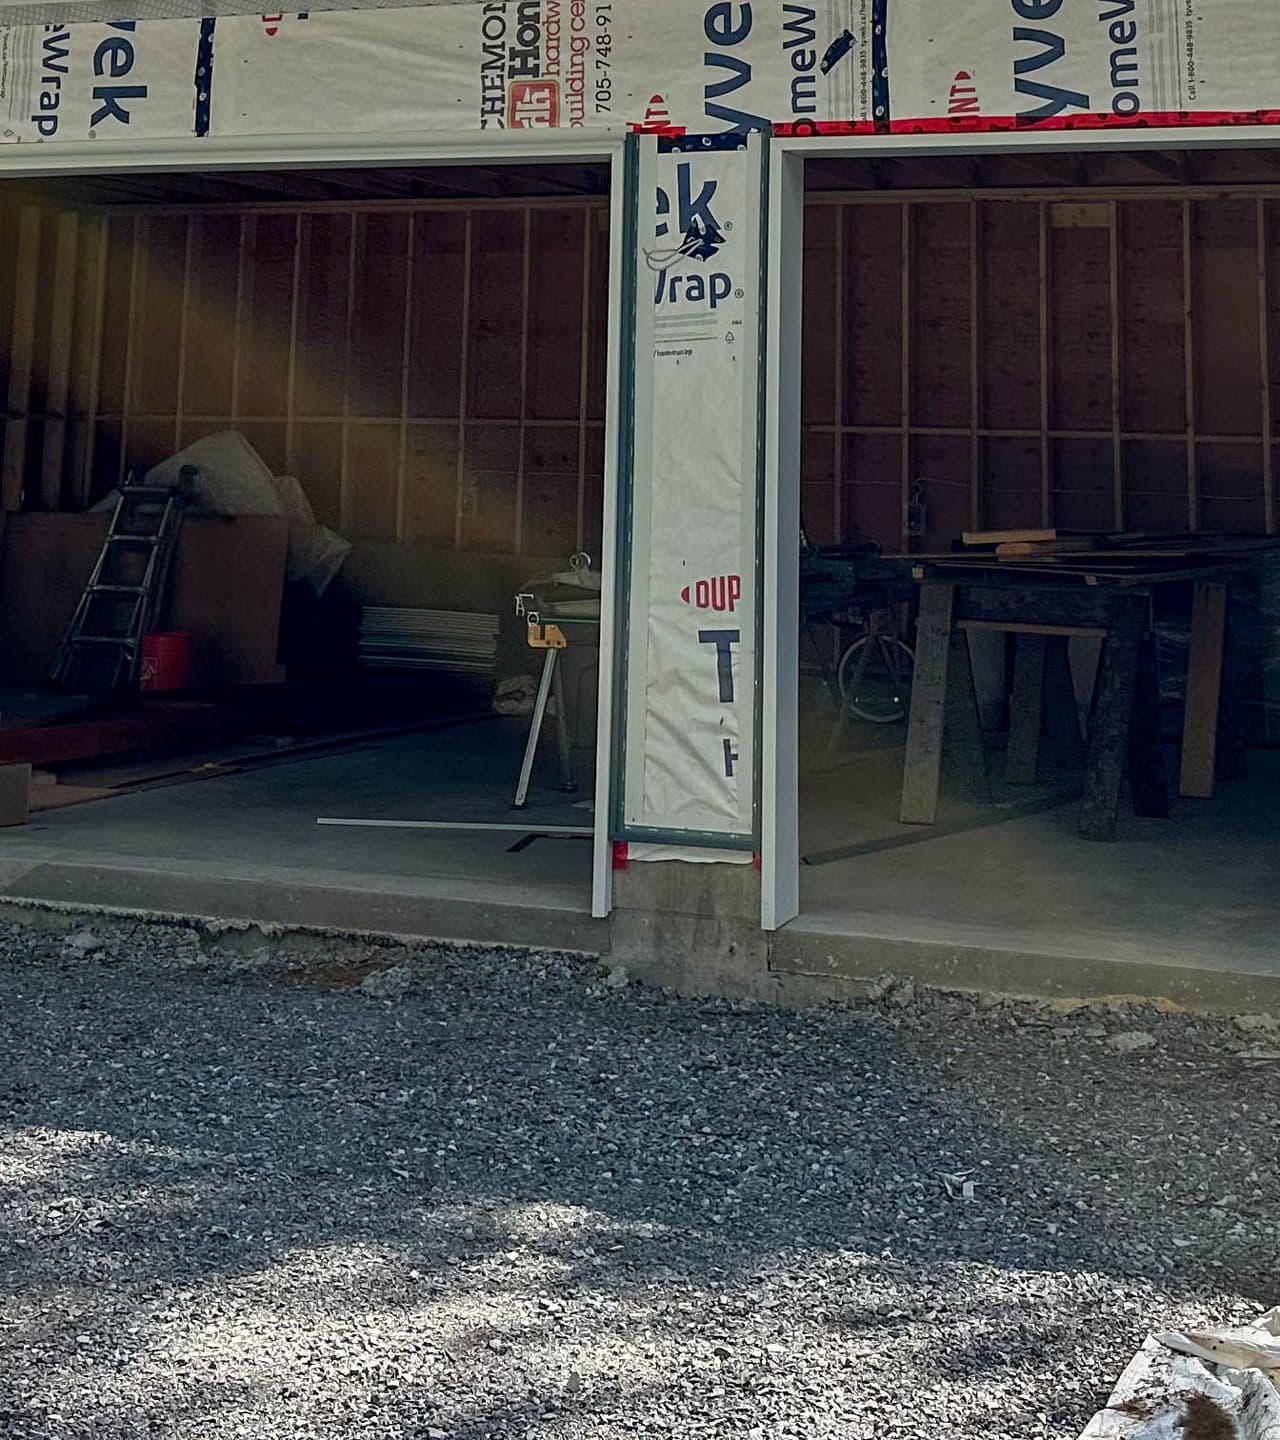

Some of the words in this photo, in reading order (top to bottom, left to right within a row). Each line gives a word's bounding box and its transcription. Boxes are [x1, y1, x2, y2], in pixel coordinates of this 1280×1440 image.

[31, 24, 70, 136] Wrap
[89, 21, 148, 128] ek
[654, 268, 732, 309] rap
